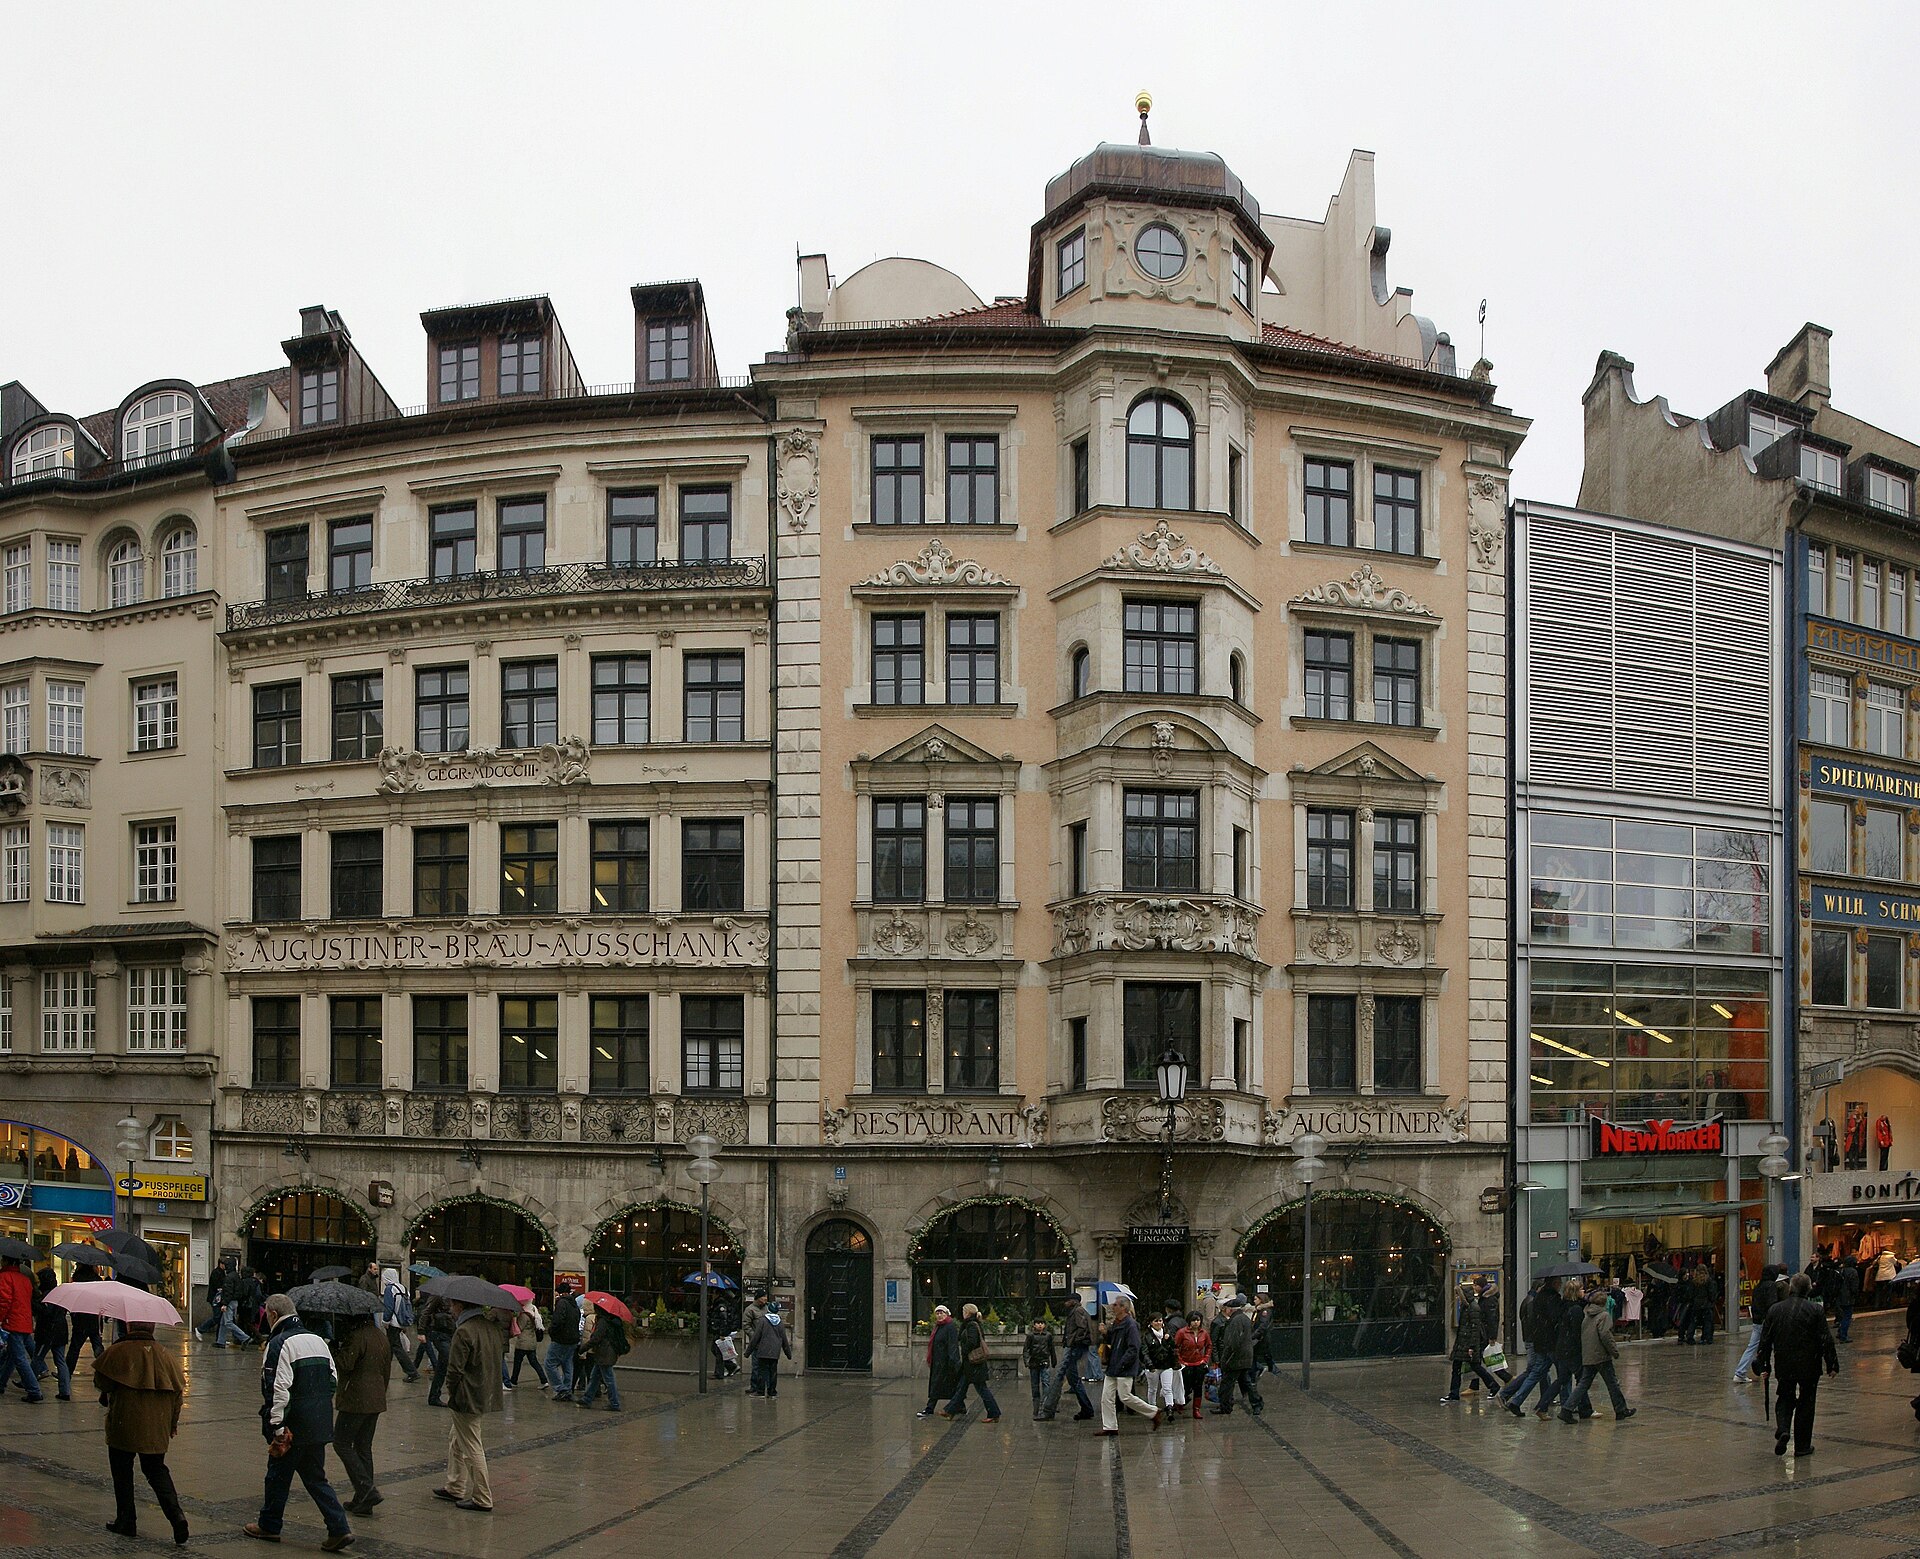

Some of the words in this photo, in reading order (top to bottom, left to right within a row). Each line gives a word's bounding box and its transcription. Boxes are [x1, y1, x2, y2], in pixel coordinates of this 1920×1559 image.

[1824, 894, 1868, 916] WILH.
[1879, 900, 1920, 922] SCHM
[853, 1112, 1019, 1135] RESTAURANT
[144, 1181, 203, 1192] FUSSPFLEGE
[1132, 1227, 1186, 1235] RESTAURANT
